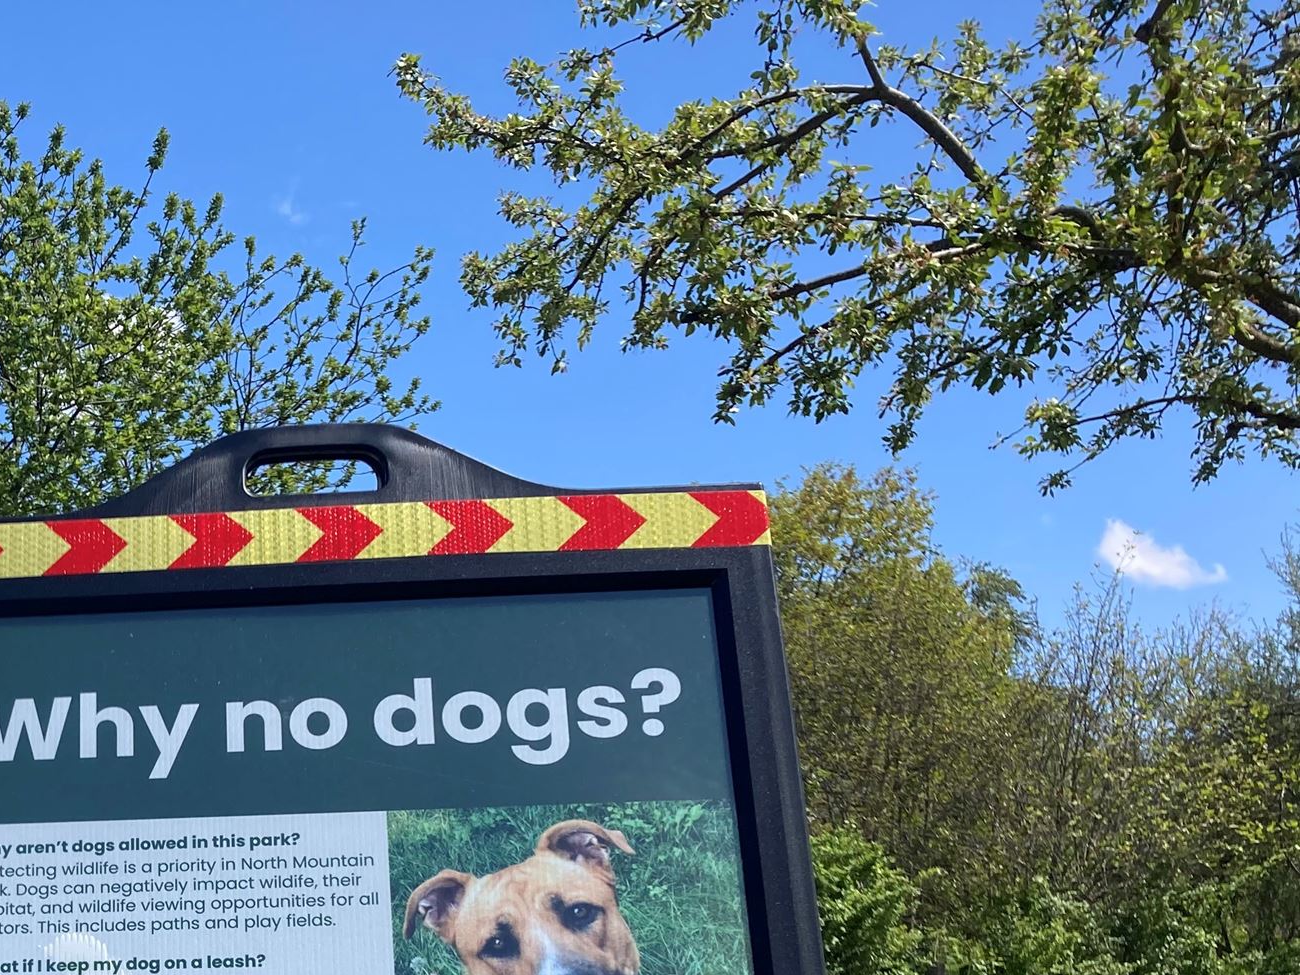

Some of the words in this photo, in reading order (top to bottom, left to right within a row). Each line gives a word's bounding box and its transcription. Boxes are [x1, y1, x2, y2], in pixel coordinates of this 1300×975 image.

[225, 697, 349, 754] no
[373, 666, 682, 766] dogs?
[71, 838, 116, 856] dogs
[117, 835, 188, 852] allowed
[191, 835, 209, 850] in
[211, 834, 246, 849] this
[249, 832, 301, 852] park?
[61, 859, 120, 876] wildlife
[123, 859, 137, 874] is
[140, 862, 153, 873] a
[157, 857, 217, 877] priority
[220, 857, 236, 871] in
[240, 855, 288, 871] North
[292, 853, 375, 869] Mountain
[15, 882, 59, 900] Dogs
[62, 883, 95, 895] can
[100, 877, 189, 897] negatively
[192, 876, 256, 895] impact
[321, 872, 363, 888] their
[37, 918, 71, 934] This
[74, 917, 147, 933] includes
[148, 915, 200, 935] paths
[202, 914, 239, 930] and
[244, 914, 282, 933] play
[285, 912, 337, 928] fields.
[22, 957, 35, 972] if
[37, 958, 43, 972] I
[45, 957, 90, 975] keep
[93, 959, 123, 975] my
[125, 955, 160, 974] dog
[161, 958, 188, 970] on
[190, 958, 203, 970] a
[206, 953, 267, 969] leash?
